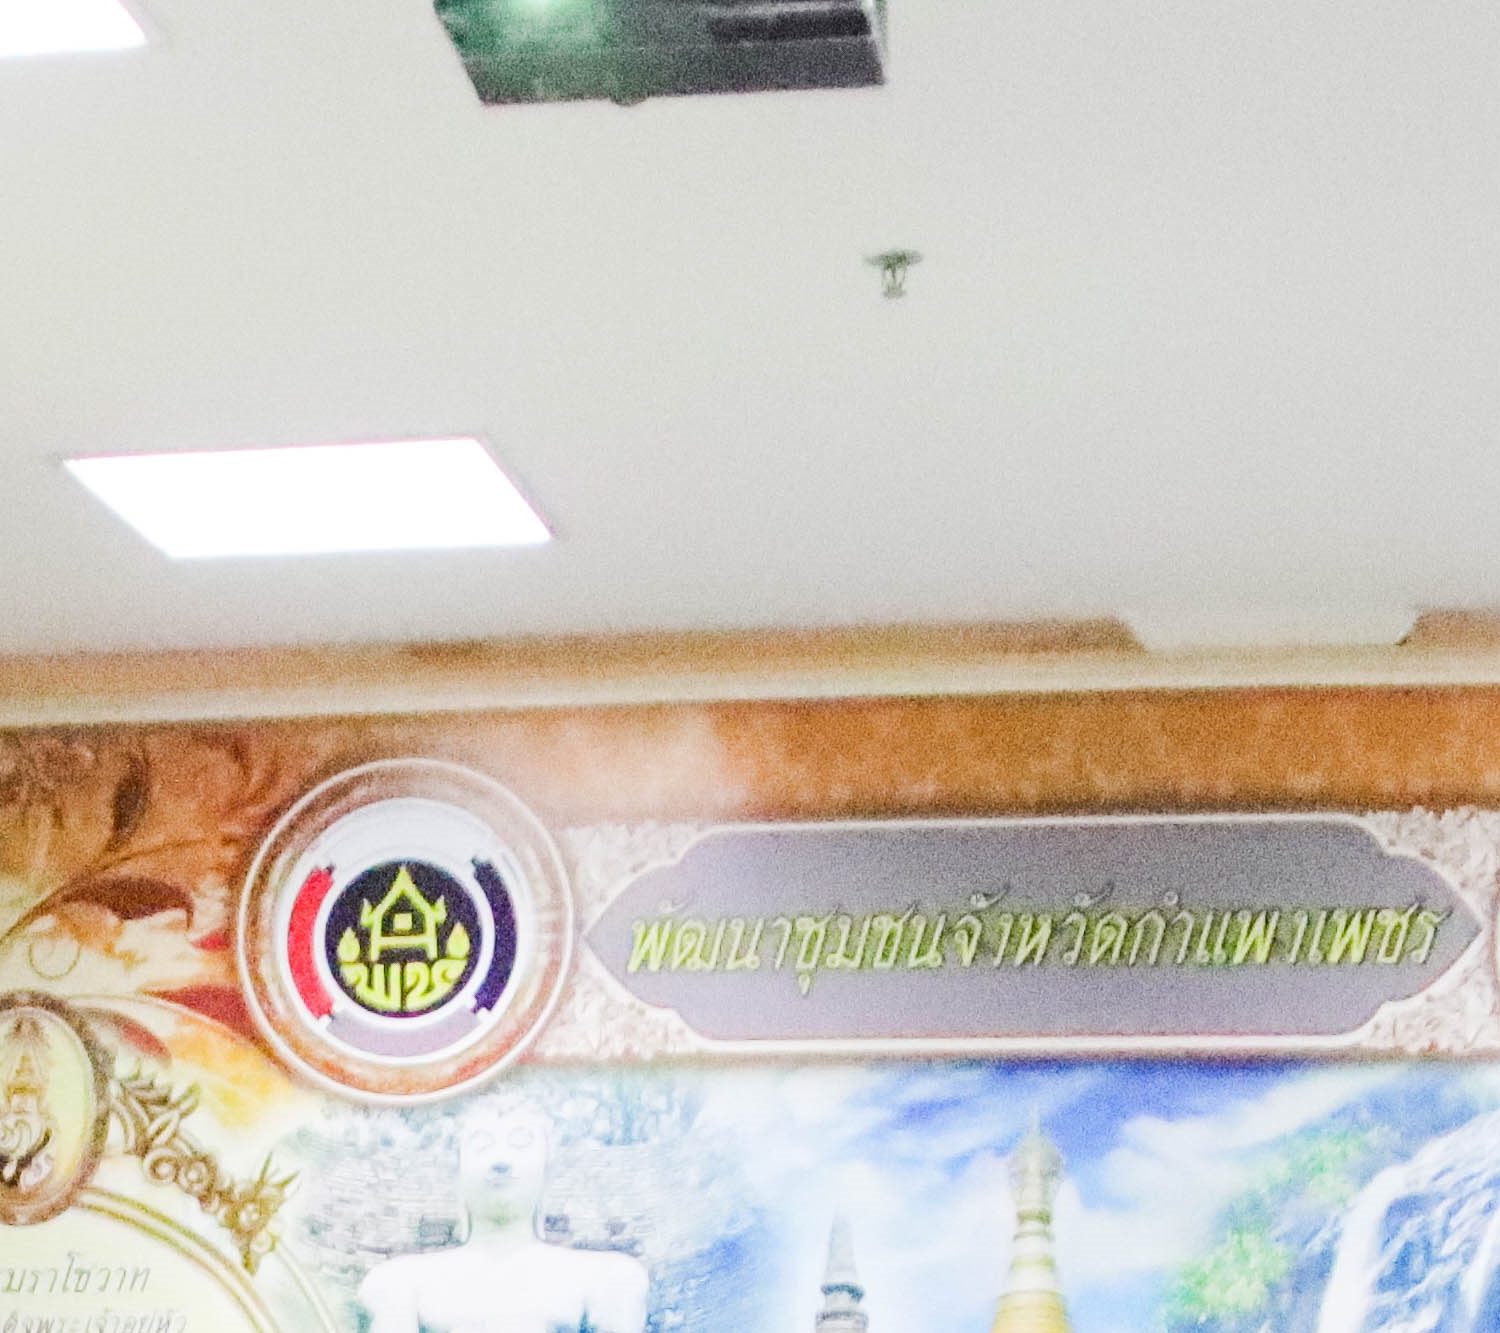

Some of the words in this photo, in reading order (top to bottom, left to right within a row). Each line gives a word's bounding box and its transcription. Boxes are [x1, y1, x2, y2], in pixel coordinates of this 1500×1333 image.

[624, 887, 1446, 994] พัฒนาชุมชนจังหวัดกำแพงเพชร
